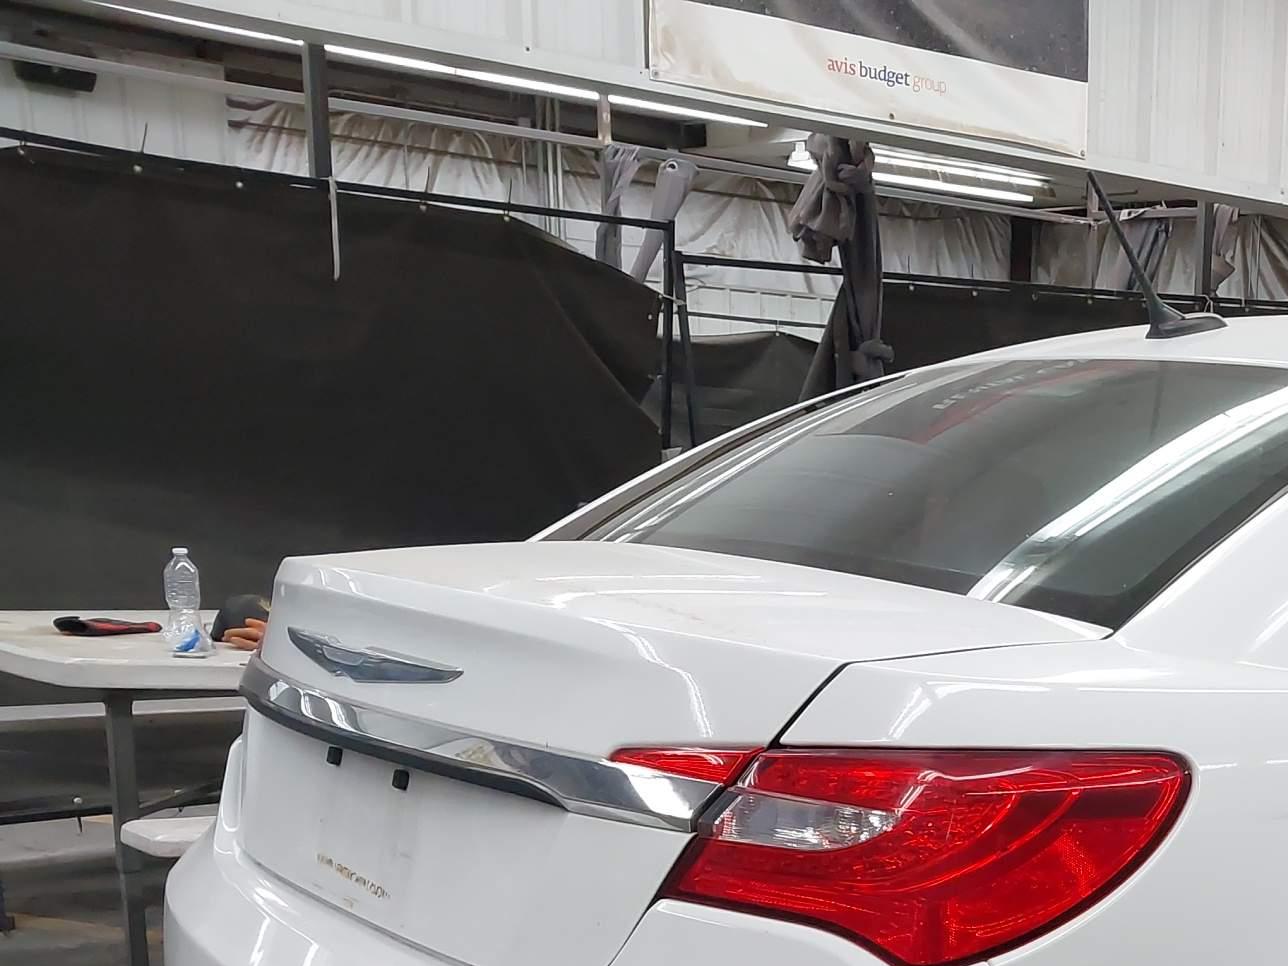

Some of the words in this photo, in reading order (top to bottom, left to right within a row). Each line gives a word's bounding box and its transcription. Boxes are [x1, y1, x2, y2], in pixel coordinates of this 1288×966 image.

[827, 57, 856, 76] avis
[859, 60, 911, 88] budget
[912, 75, 947, 96] group
